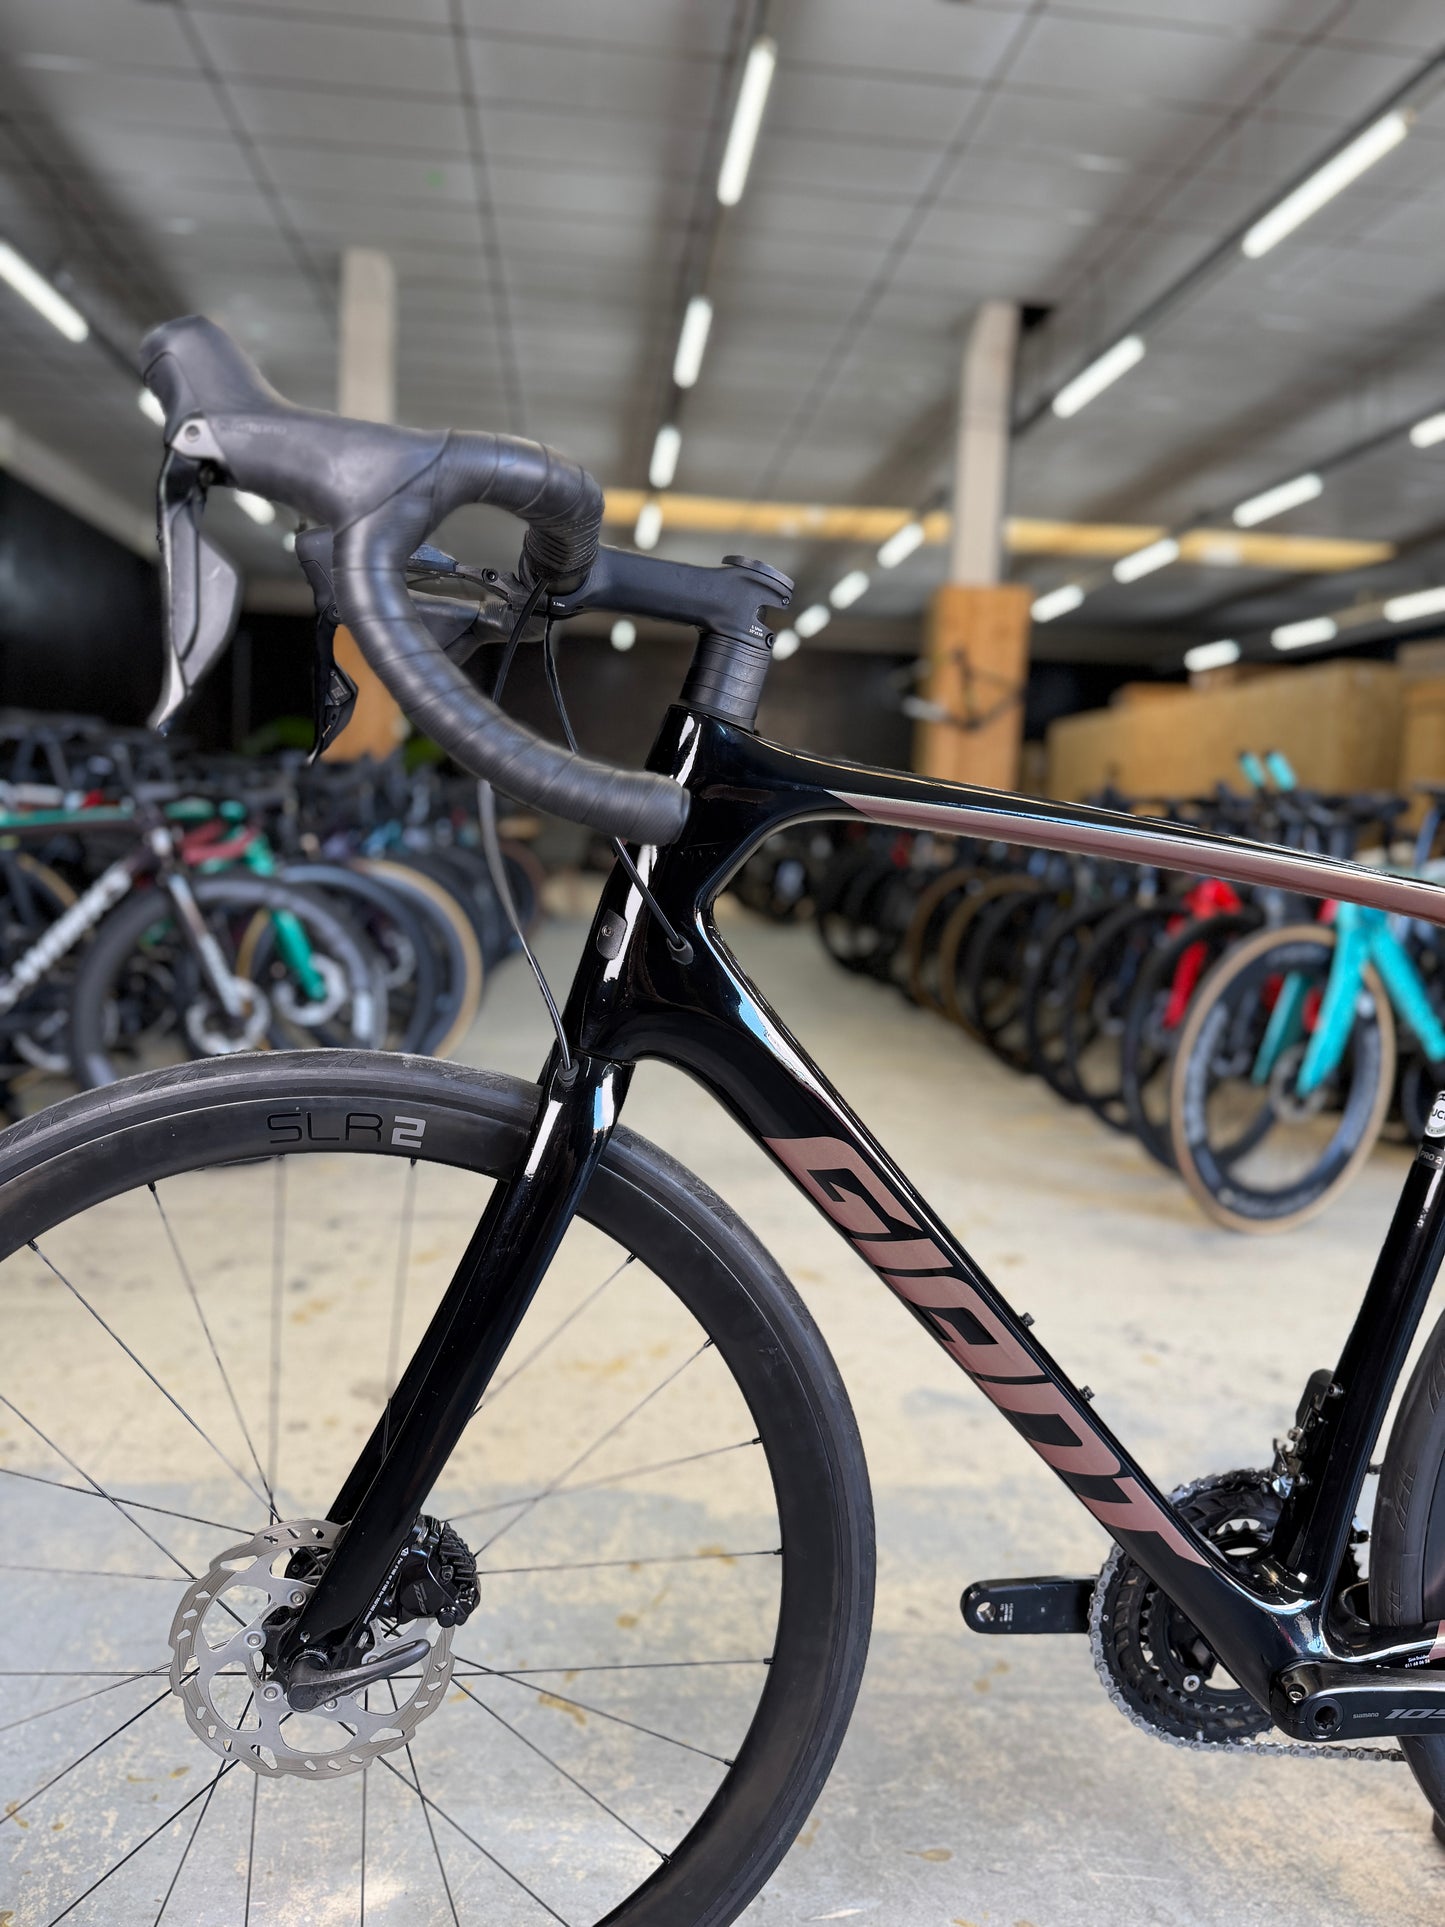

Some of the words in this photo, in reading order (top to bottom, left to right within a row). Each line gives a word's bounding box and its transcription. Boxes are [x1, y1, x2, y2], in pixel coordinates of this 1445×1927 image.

[1420, 1150, 1435, 1161] PRO
[1434, 1156, 1443, 1165] 2
[762, 1136, 1211, 1567] GIANT
